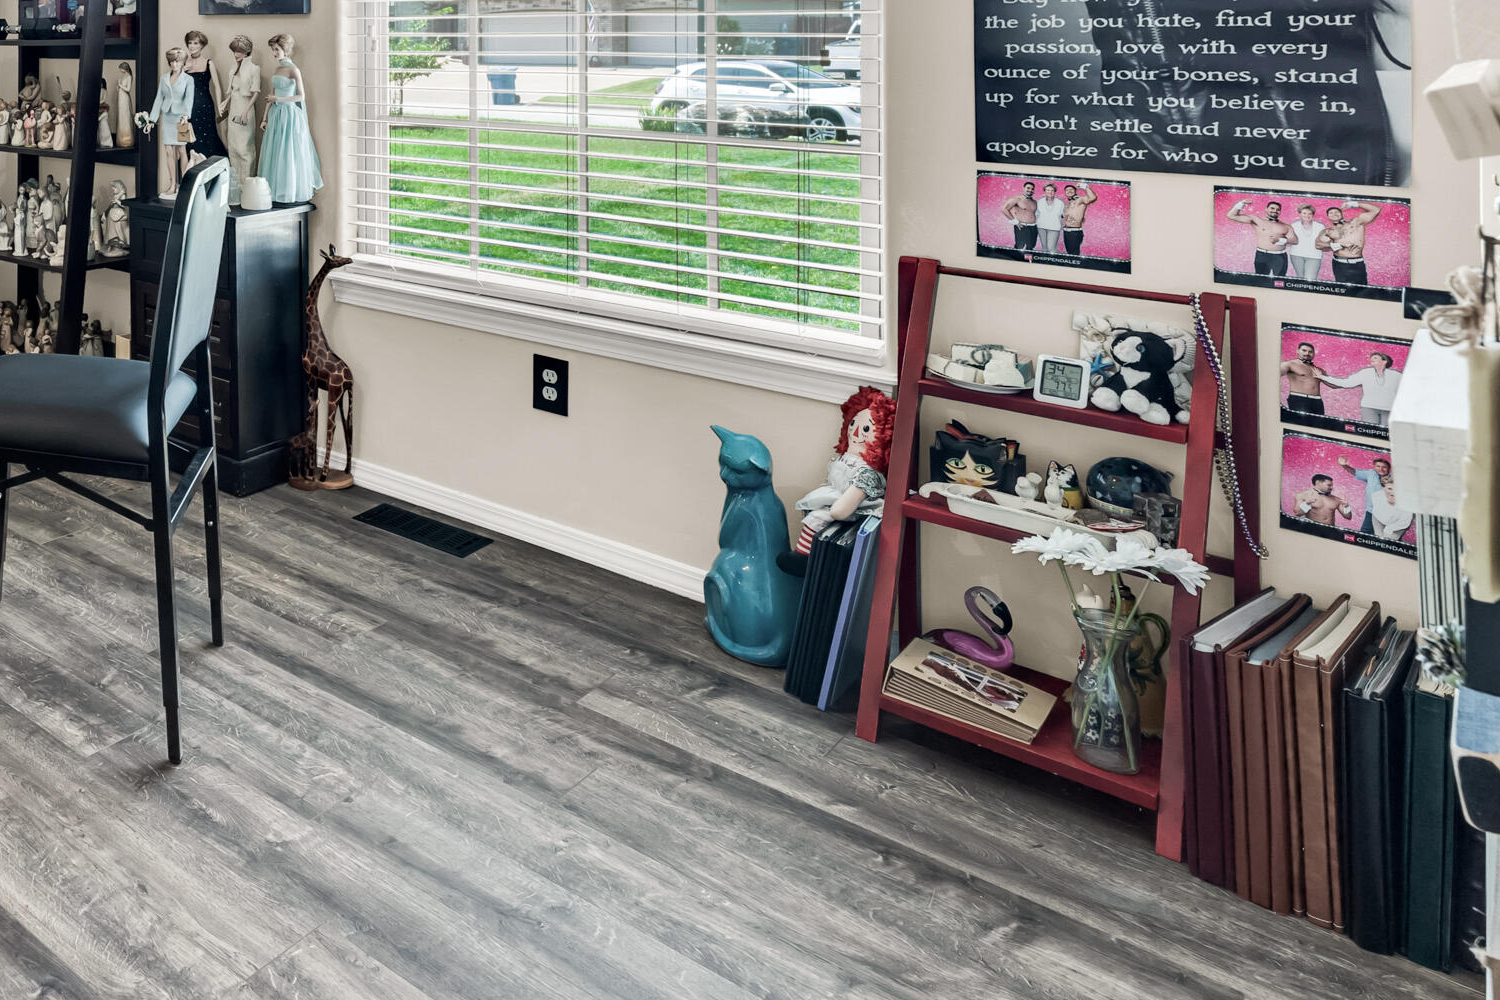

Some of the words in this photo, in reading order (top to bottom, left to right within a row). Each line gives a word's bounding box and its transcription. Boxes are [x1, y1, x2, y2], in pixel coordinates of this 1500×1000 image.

[985, 15, 1018, 29] the
[1028, 13, 1065, 33] job
[1078, 14, 1123, 33] you
[1137, 12, 1201, 30] hate,
[1215, 10, 1272, 27] find
[1288, 13, 1356, 31] your
[1005, 39, 1101, 58] passion,
[1115, 40, 1164, 55] love
[1178, 38, 1236, 54] with
[1252, 41, 1327, 60] every
[984, 65, 1050, 80] ounce
[1063, 64, 1089, 80] of
[1101, 67, 1159, 86] your
[1174, 67, 1259, 85] bones,
[1274, 67, 1358, 84] stand
[985, 91, 1013, 106] up
[1025, 89, 1060, 104] for
[1072, 91, 1134, 106] what
[1147, 94, 1195, 113] you
[1211, 93, 1304, 111] believe
[1319, 95, 1356, 115] in,
[1021, 115, 1077, 131] don't
[1090, 117, 1153, 134] settle
[1167, 121, 1219, 137] and
[1234, 125, 1310, 140] never
[986, 140, 1098, 161] apologize
[1111, 144, 1148, 161] for
[1162, 149, 1218, 163] who
[1233, 153, 1284, 170] you
[1301, 156, 1358, 171] are.
[1286, 282, 1346, 294] CHIPPENDALES
